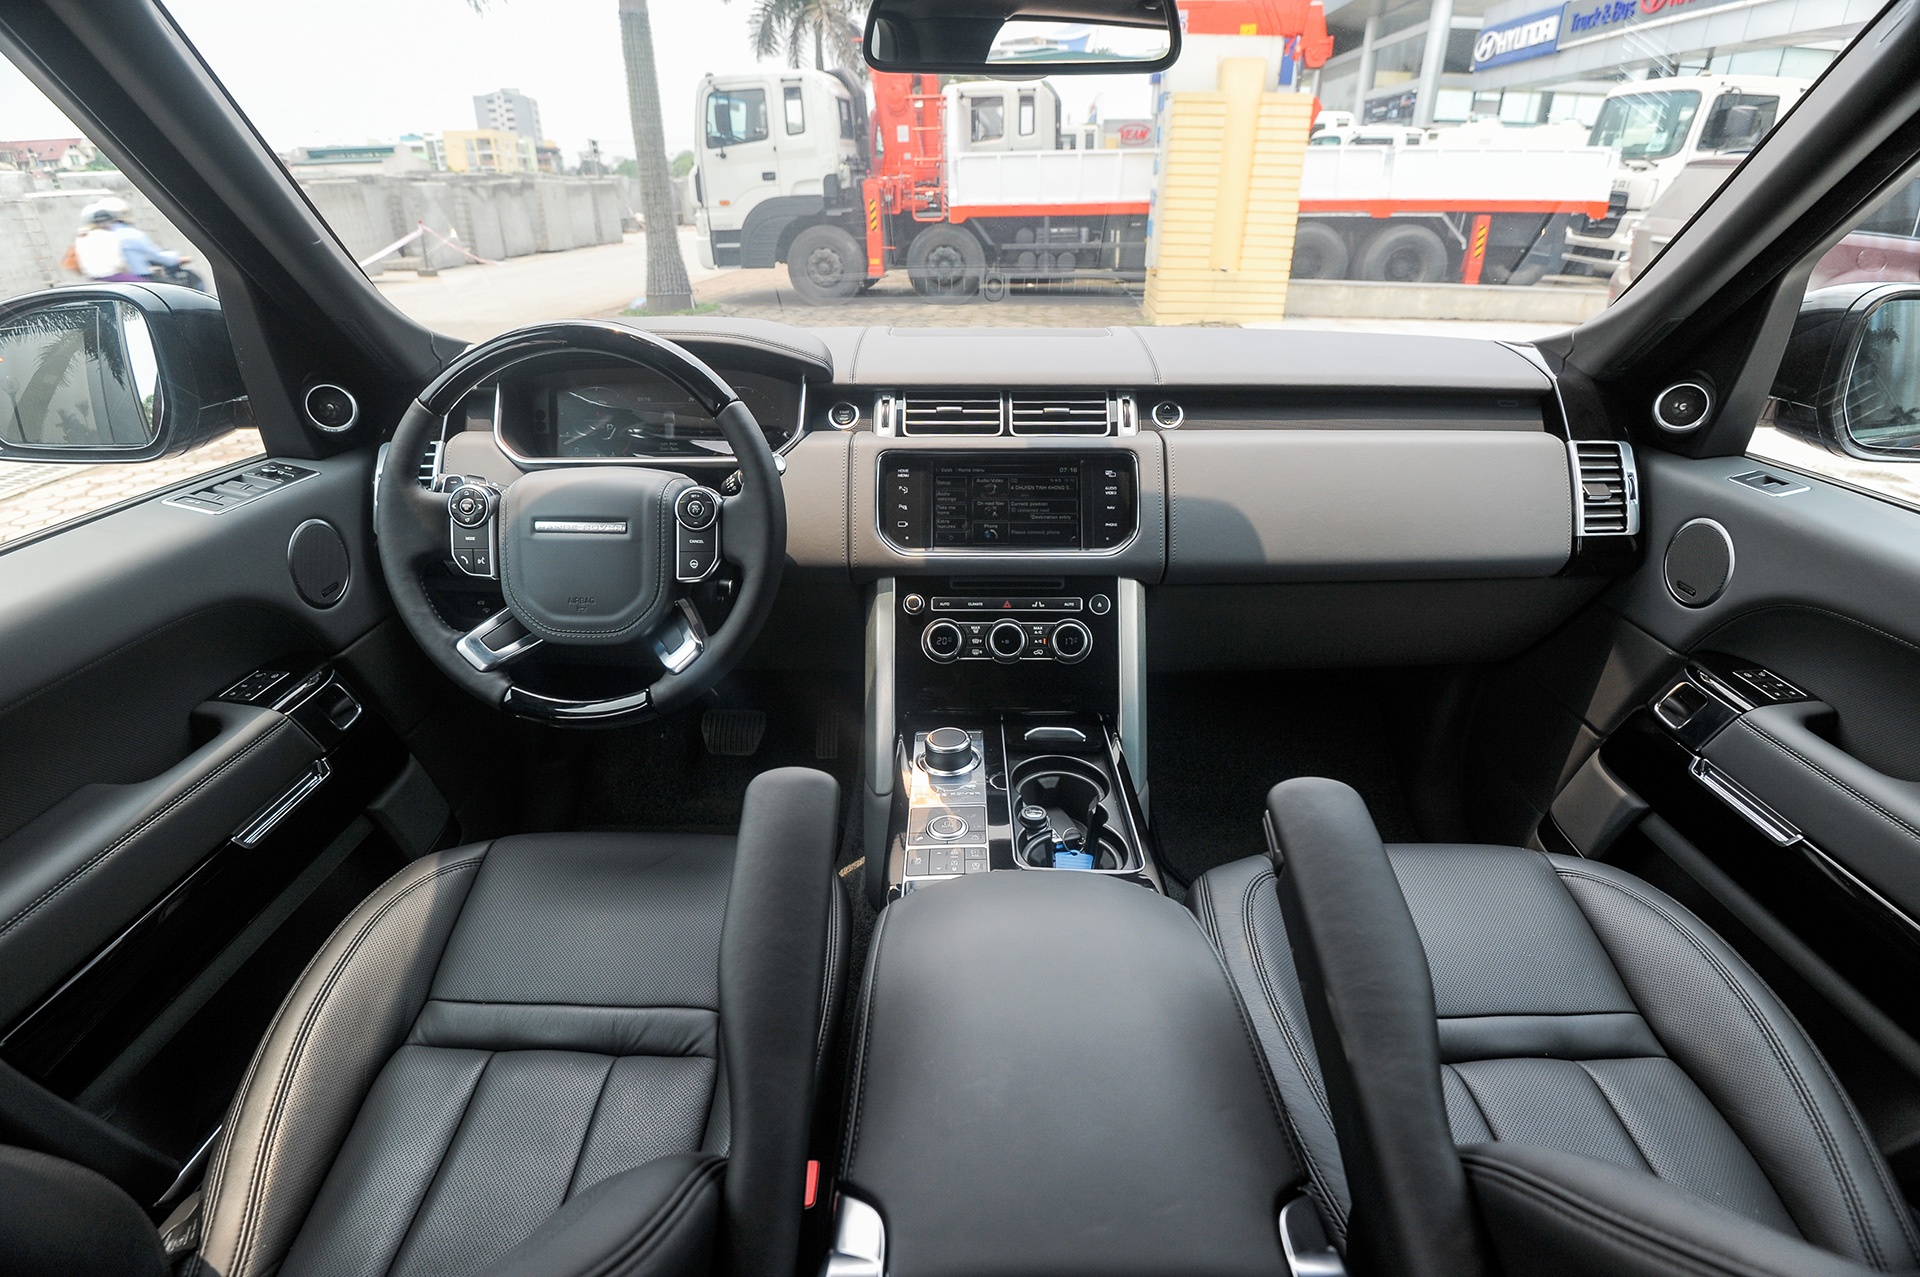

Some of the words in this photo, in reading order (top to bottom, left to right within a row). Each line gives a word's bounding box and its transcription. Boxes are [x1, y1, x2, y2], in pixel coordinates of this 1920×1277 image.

[1570, 7, 1601, 33] Truck
[1602, 4, 1612, 24] &
[1612, 1, 1636, 22] Bus
[1496, 14, 1559, 55] HYUNDAI
[567, 596, 595, 604] AIRBAG
